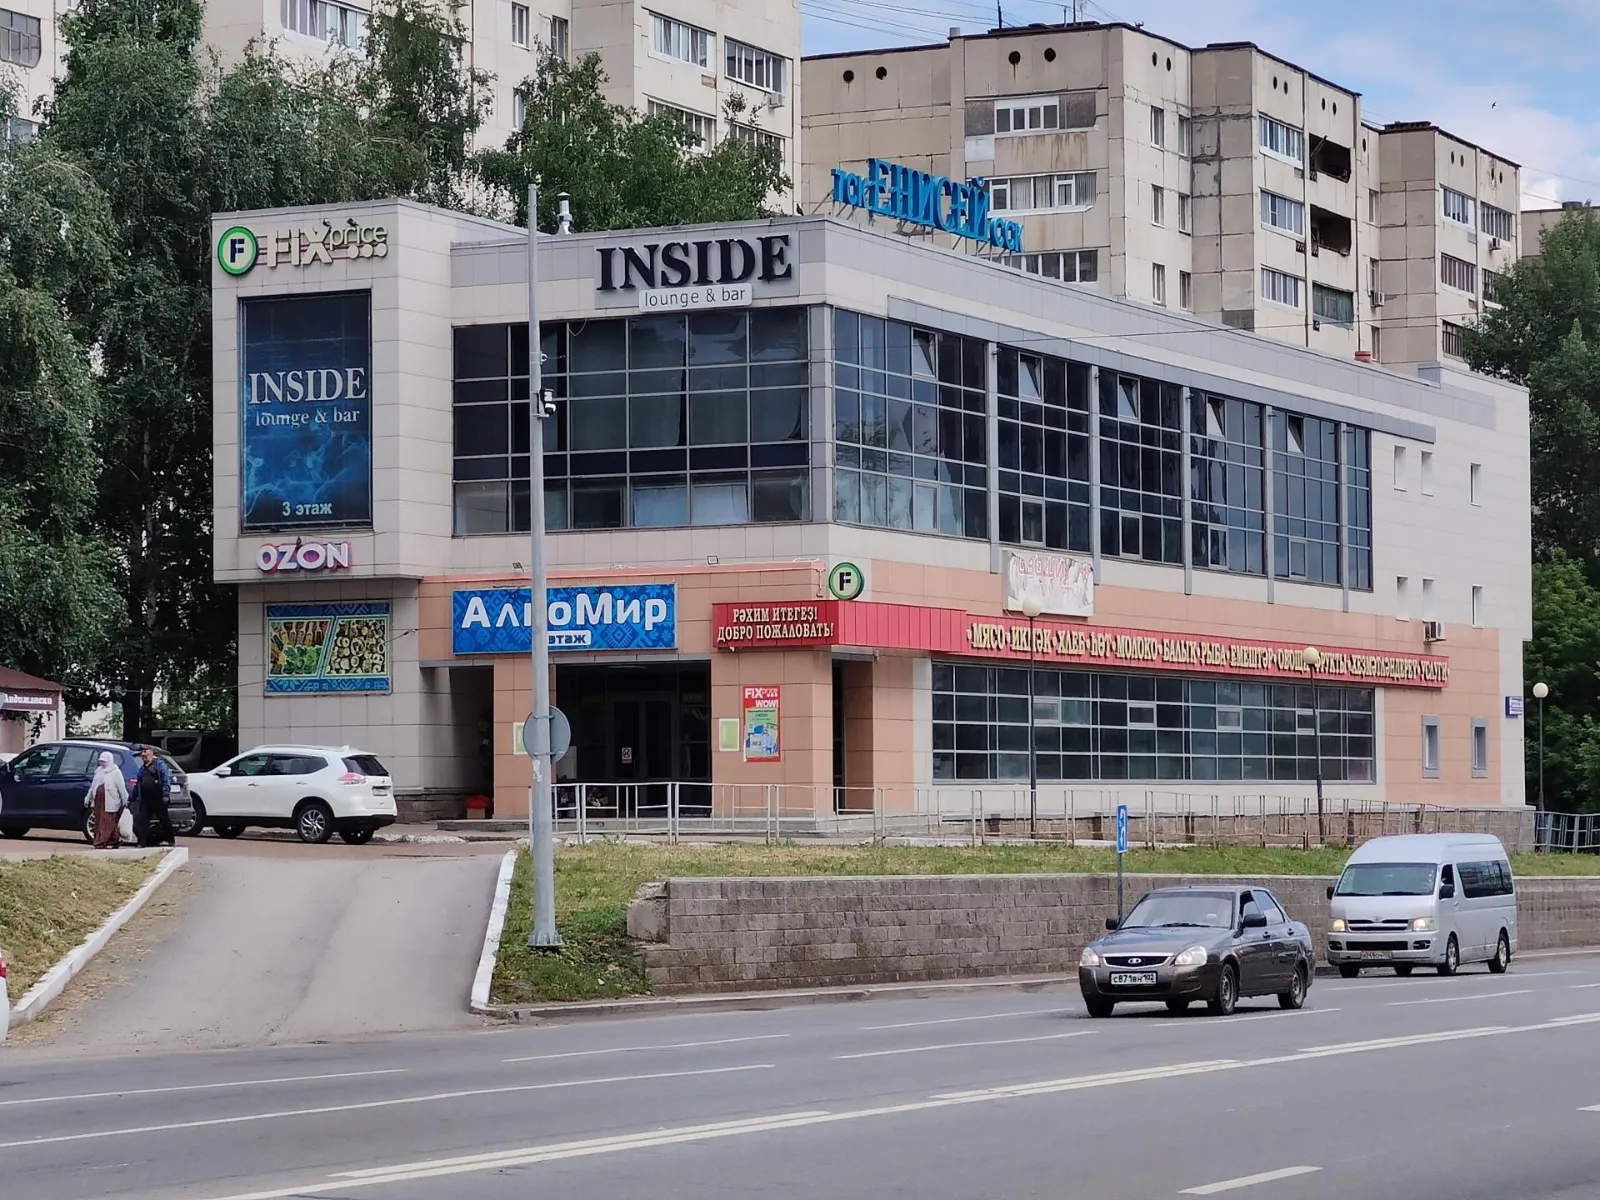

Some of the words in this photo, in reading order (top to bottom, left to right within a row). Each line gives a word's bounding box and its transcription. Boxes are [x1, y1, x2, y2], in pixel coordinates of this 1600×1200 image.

[868, 158, 990, 243] ЕНИСЕЙ
[266, 227, 333, 267] FIX
[329, 225, 388, 250] price
[596, 234, 792, 291] INSIDE
[645, 291, 699, 308] lounge
[706, 288, 716, 302] &
[722, 287, 746, 302] bar
[248, 367, 367, 404] INSIDE
[255, 410, 310, 429] lounge
[315, 407, 328, 424] &
[334, 408, 360, 423] bar
[282, 501, 291, 517] 3
[295, 502, 333, 516] этаж
[256, 542, 350, 572] OZON
[733, 607, 770, 623] РӘХИМ
[548, 634, 587, 645] этаж
[717, 625, 753, 643] ДОБРО
[756, 623, 834, 640] ПОЖАЛОВАТЬ!
[973, 623, 1006, 650] МЯСО
[1057, 630, 1086, 656] ХЛЕБ
[1116, 635, 1158, 661] МОЛОКО
[1200, 642, 1226, 666] РЫБА
[744, 688, 763, 699] FIX
